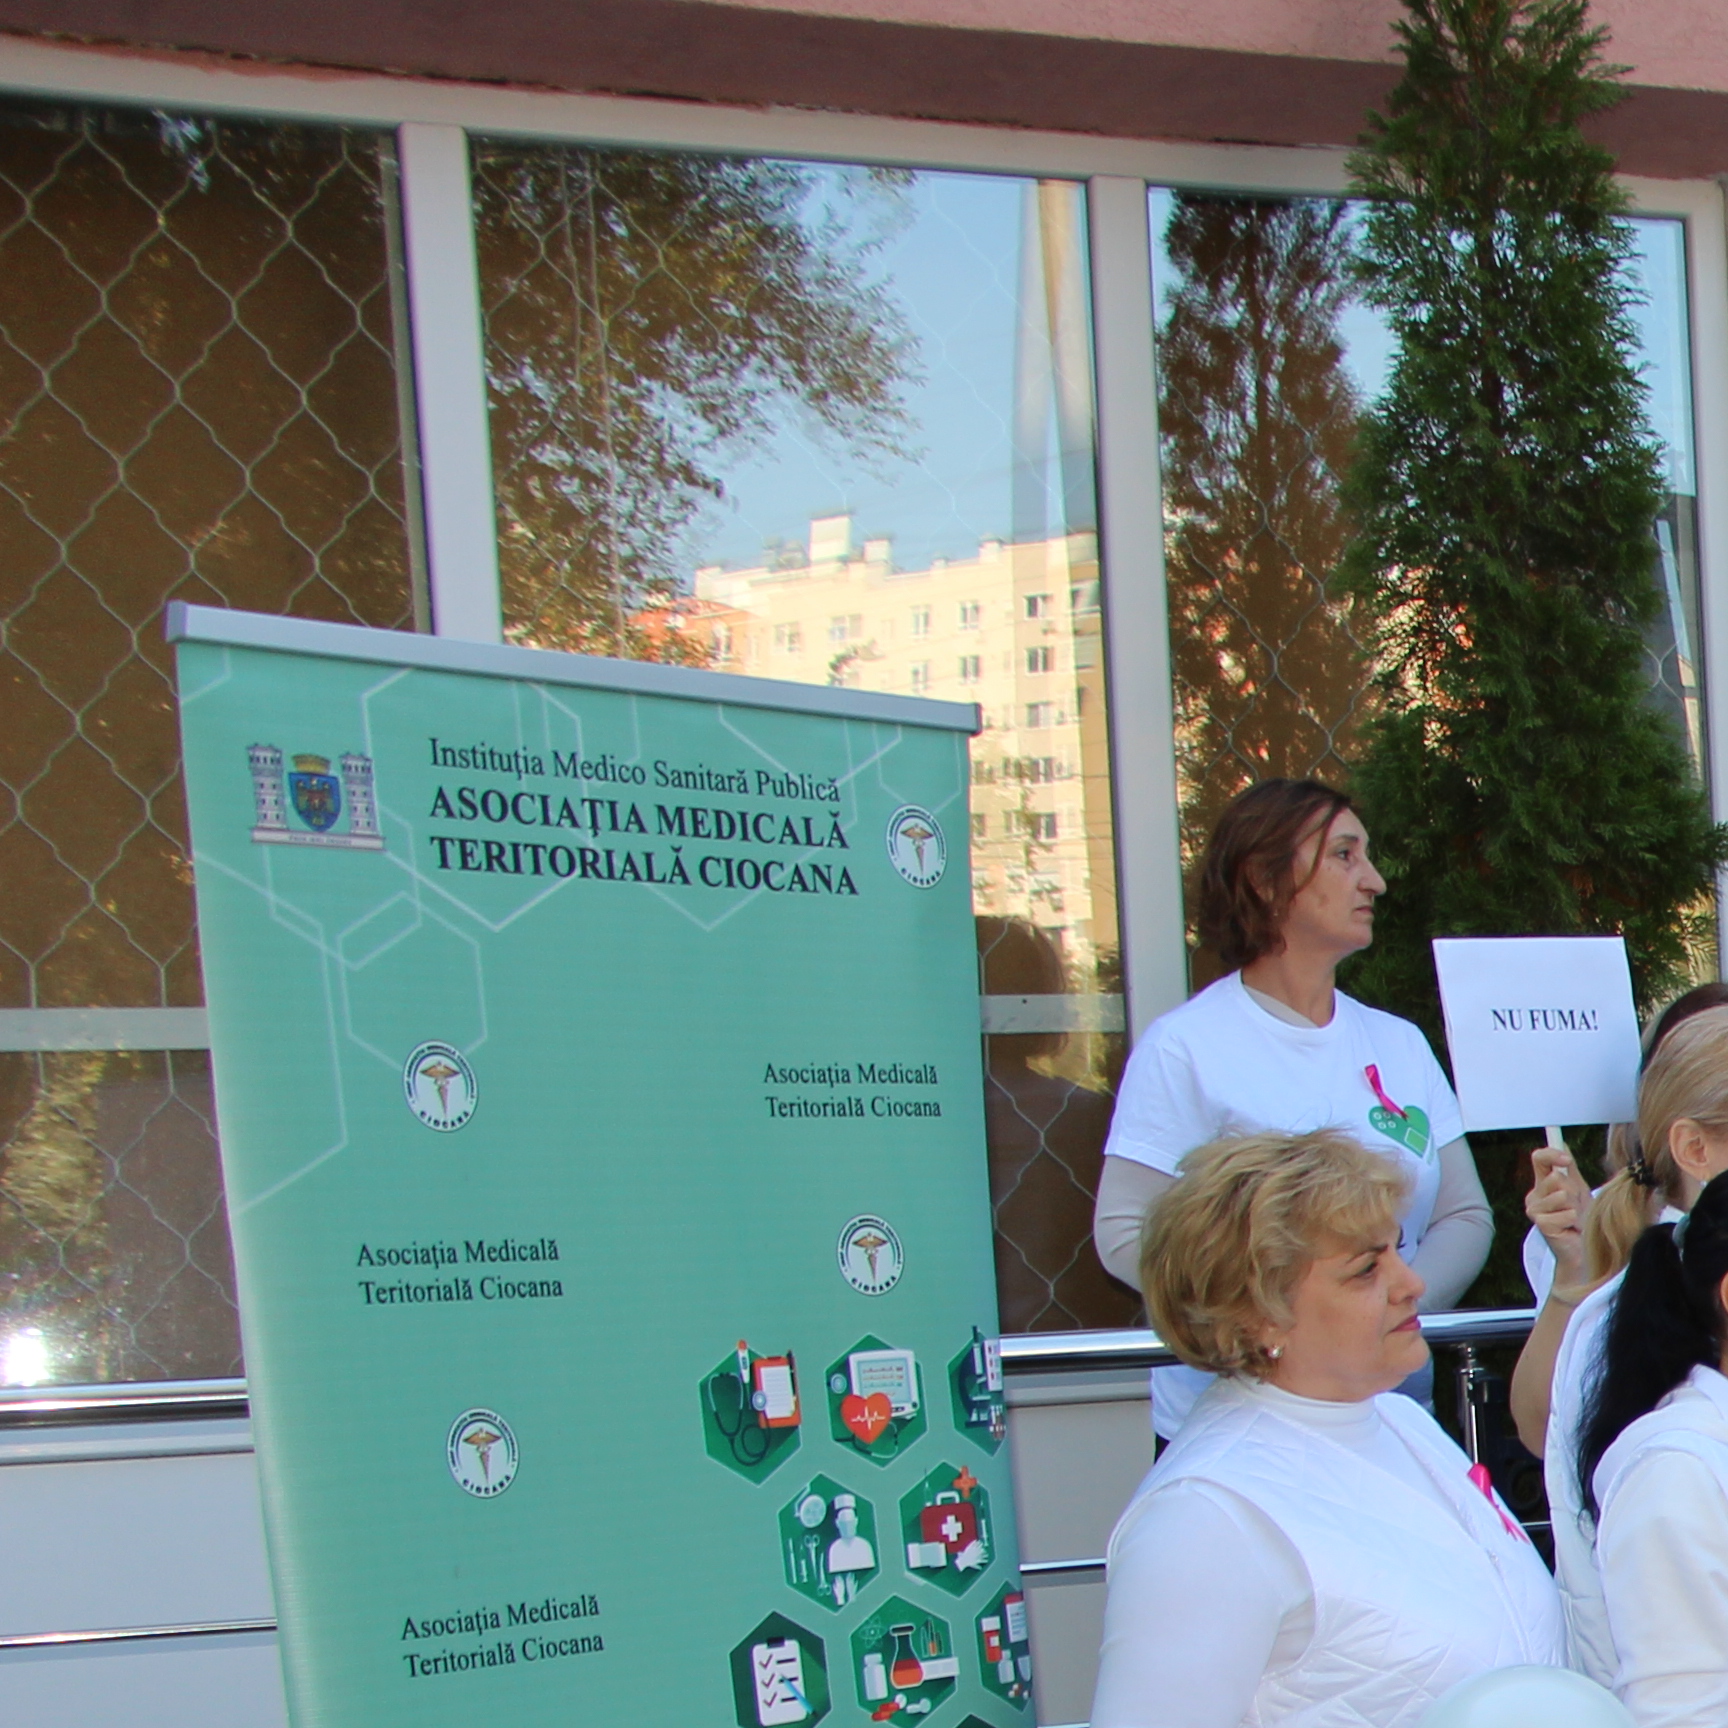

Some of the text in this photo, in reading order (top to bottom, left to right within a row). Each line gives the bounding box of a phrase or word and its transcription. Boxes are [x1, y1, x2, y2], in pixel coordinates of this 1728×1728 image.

[429, 738, 840, 803] Instituția Medico Sanitară Publică
[430, 786, 647, 837] ASOCIAȚIA
[657, 802, 850, 850] MEDICALĂ
[430, 836, 859, 895] TERITORIALĂ CIOCANA
[1490, 1009, 1600, 1031] NU FUMA!
[763, 1062, 938, 1089] Asociația Medicală
[764, 1095, 942, 1118] Teritorială Ciocana
[357, 1237, 559, 1271] Asociația Medicală
[358, 1273, 563, 1304] Teritorială Ciocana
[400, 1594, 600, 1642] Asociația Medicală
[403, 1632, 604, 1678] Teritorială Ciocana
